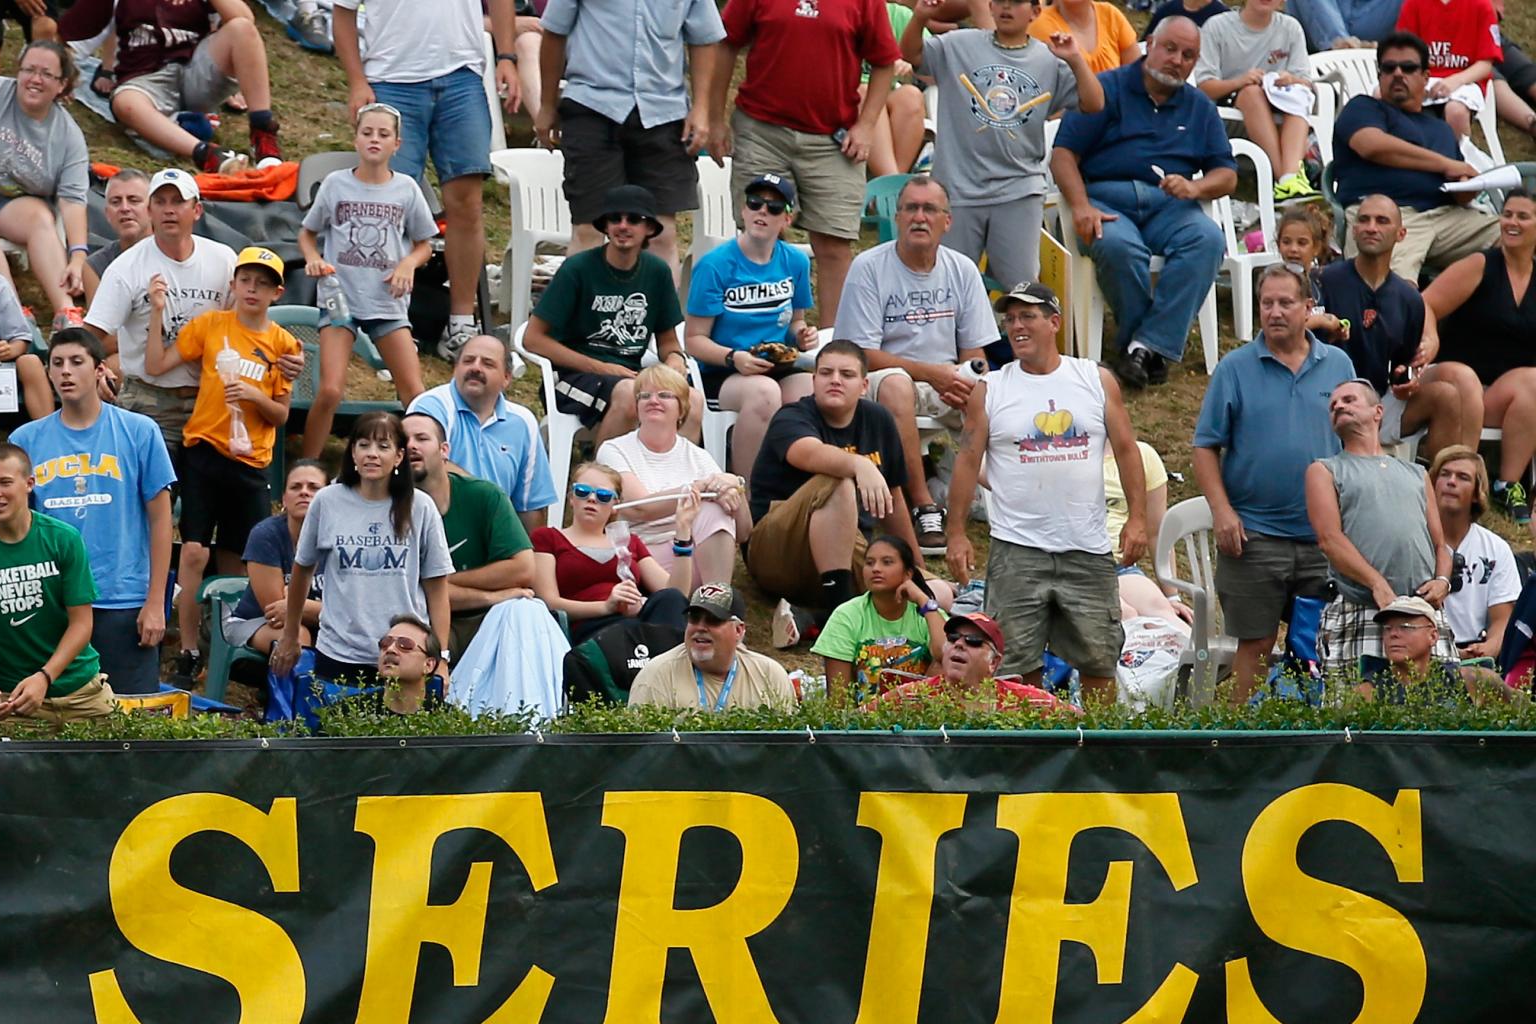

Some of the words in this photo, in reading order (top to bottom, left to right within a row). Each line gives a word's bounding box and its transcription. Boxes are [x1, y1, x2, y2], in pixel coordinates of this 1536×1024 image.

[180, 288, 223, 303] STATE
[724, 278, 793, 302] OUTHEAS
[33, 453, 123, 487] UCLA
[50, 496, 106, 508] BASEBALL
[336, 535, 410, 547] BASEBALL
[0, 594, 44, 615] STOPS
